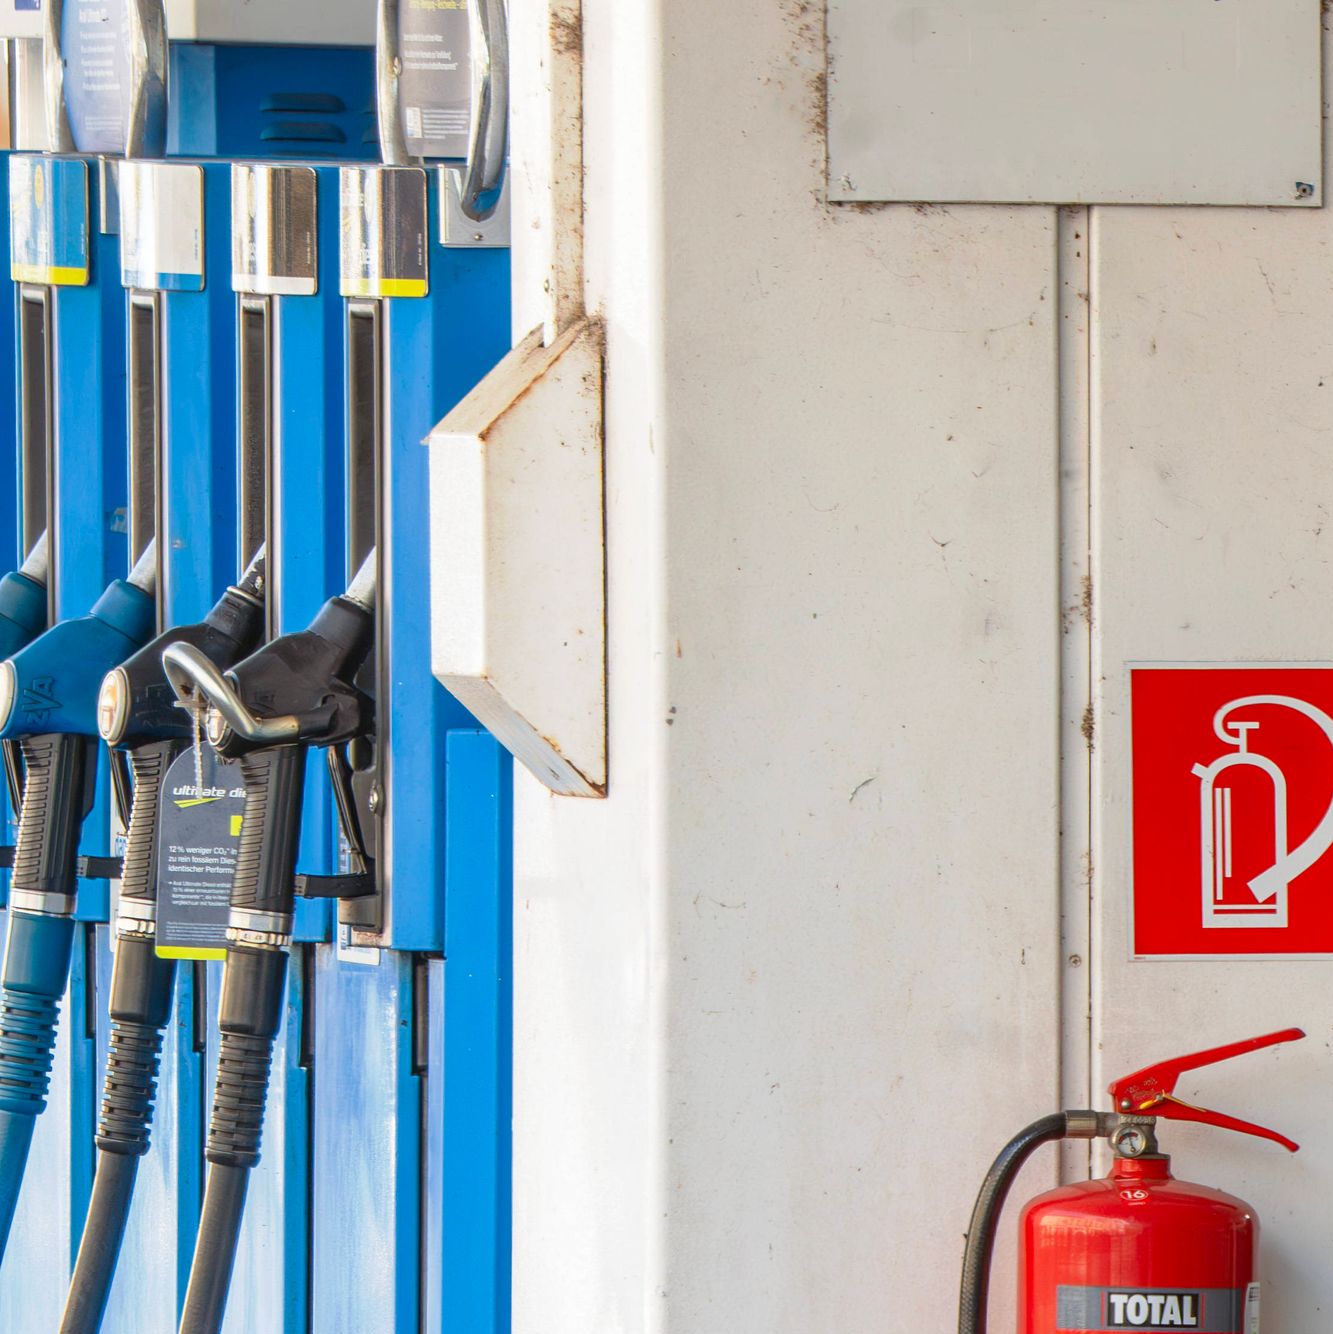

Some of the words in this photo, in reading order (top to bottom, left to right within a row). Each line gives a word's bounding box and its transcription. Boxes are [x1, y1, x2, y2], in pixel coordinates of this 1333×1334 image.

[173, 785, 226, 797] ultiate
[1125, 1189, 1146, 1199] 16
[1110, 1293, 1197, 1325] TOTAL
